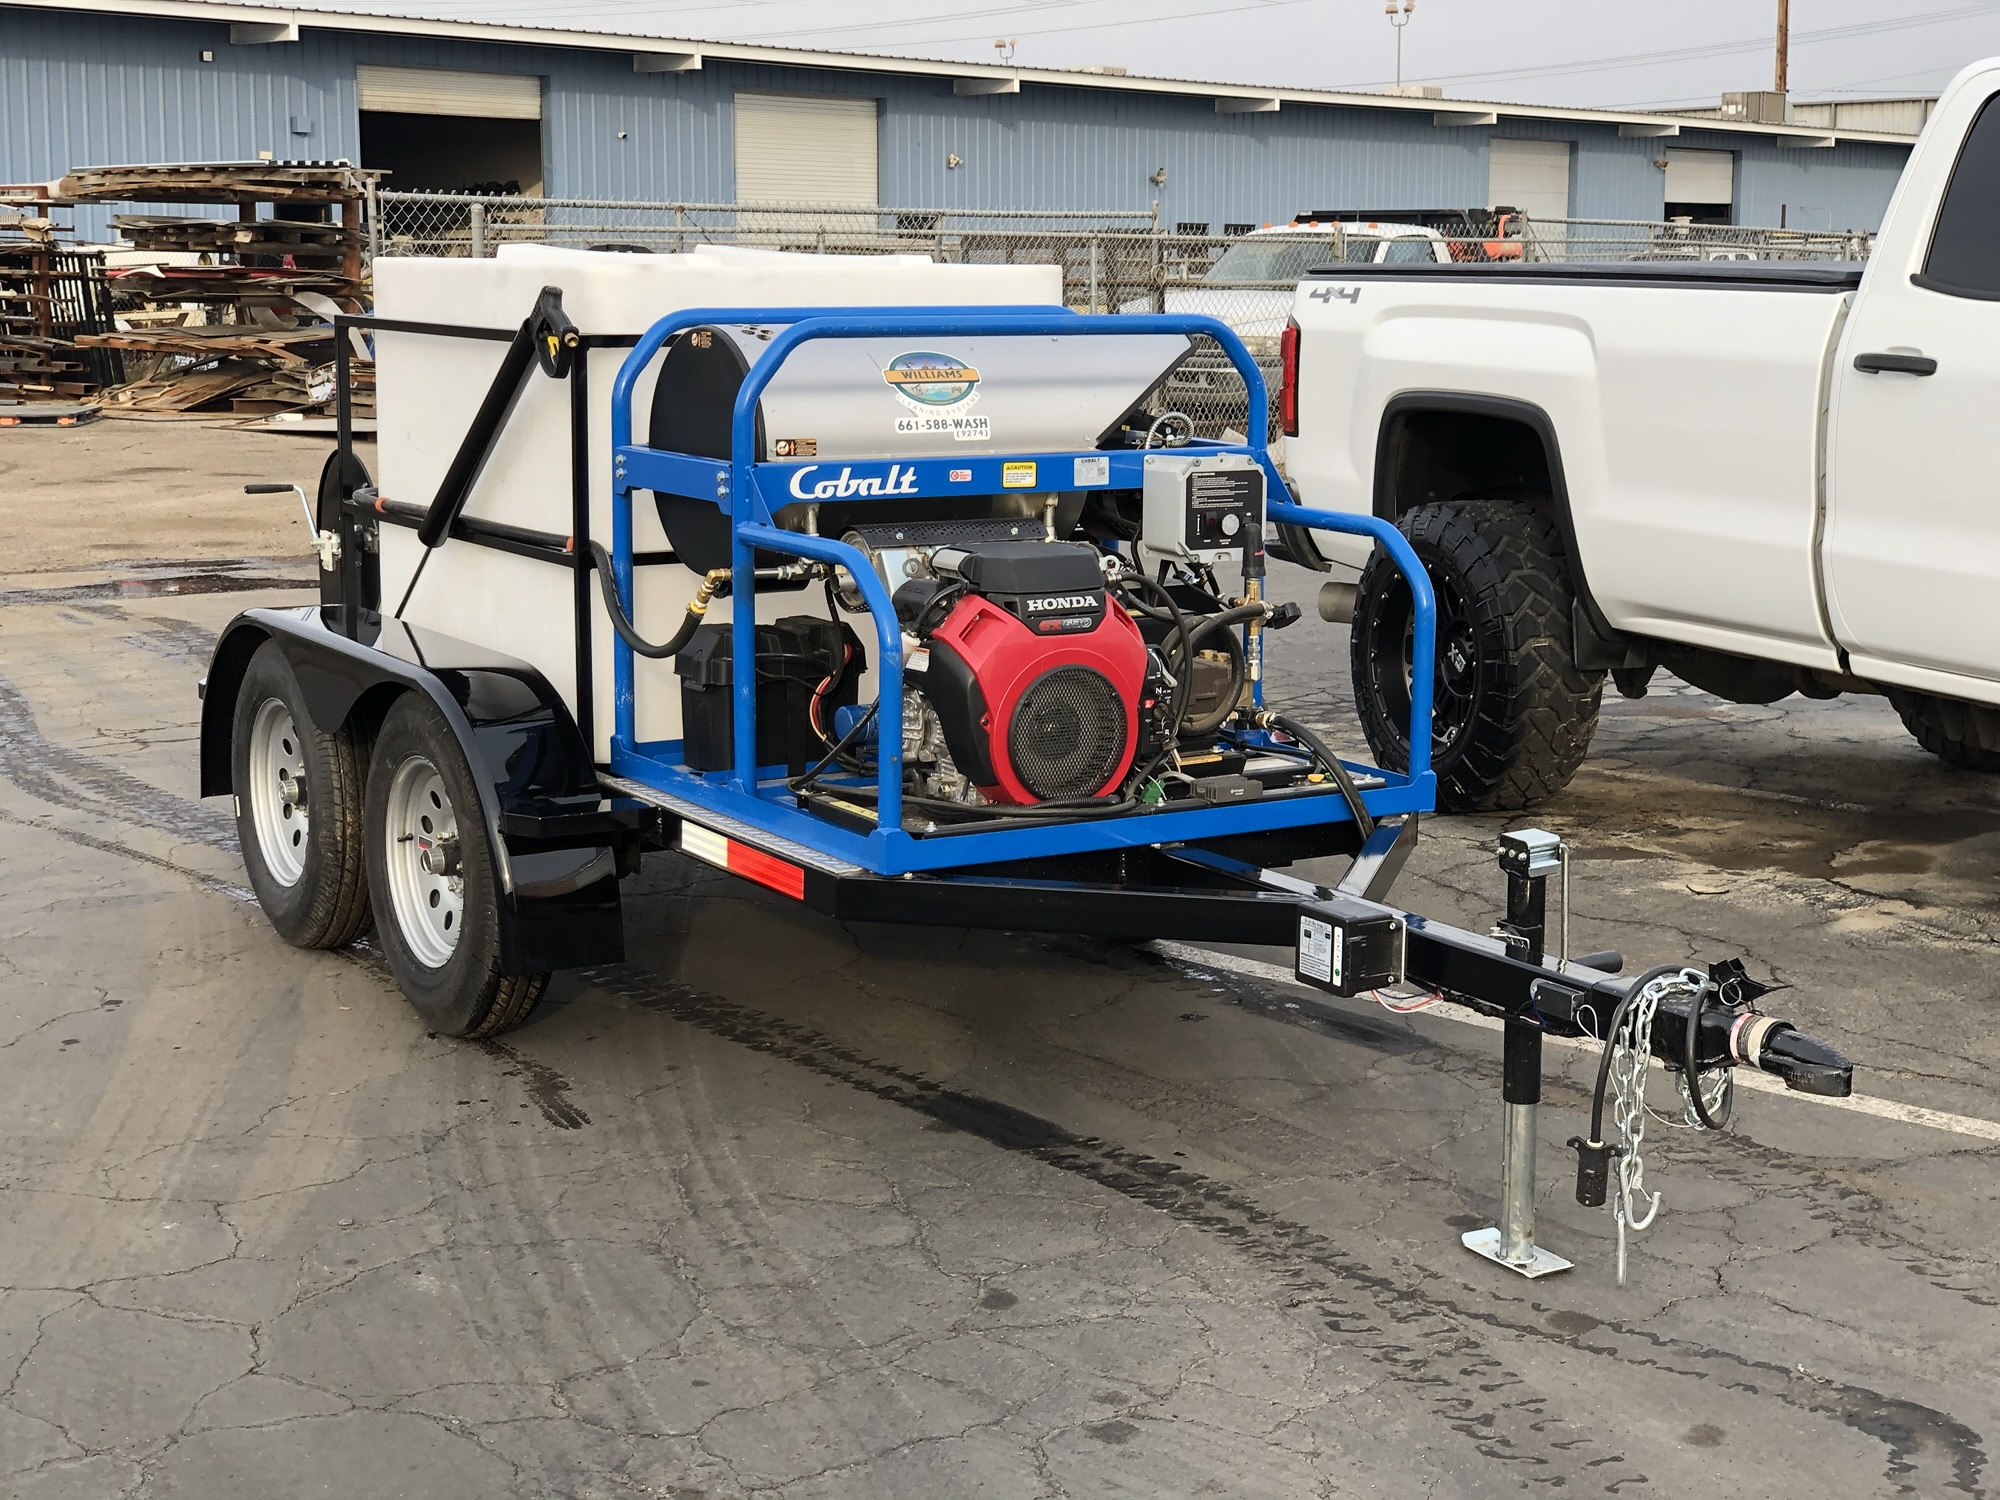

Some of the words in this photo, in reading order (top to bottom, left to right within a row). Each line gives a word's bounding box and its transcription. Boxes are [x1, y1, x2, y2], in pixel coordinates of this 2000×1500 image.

[901, 370, 963, 380] WILLIAMS
[896, 394, 941, 416] CLEANING
[946, 392, 980, 416] SYSTEMS
[898, 418, 988, 431] 661-588-WASH
[790, 465, 919, 499] Cobalt
[1027, 596, 1098, 611] HONDA
